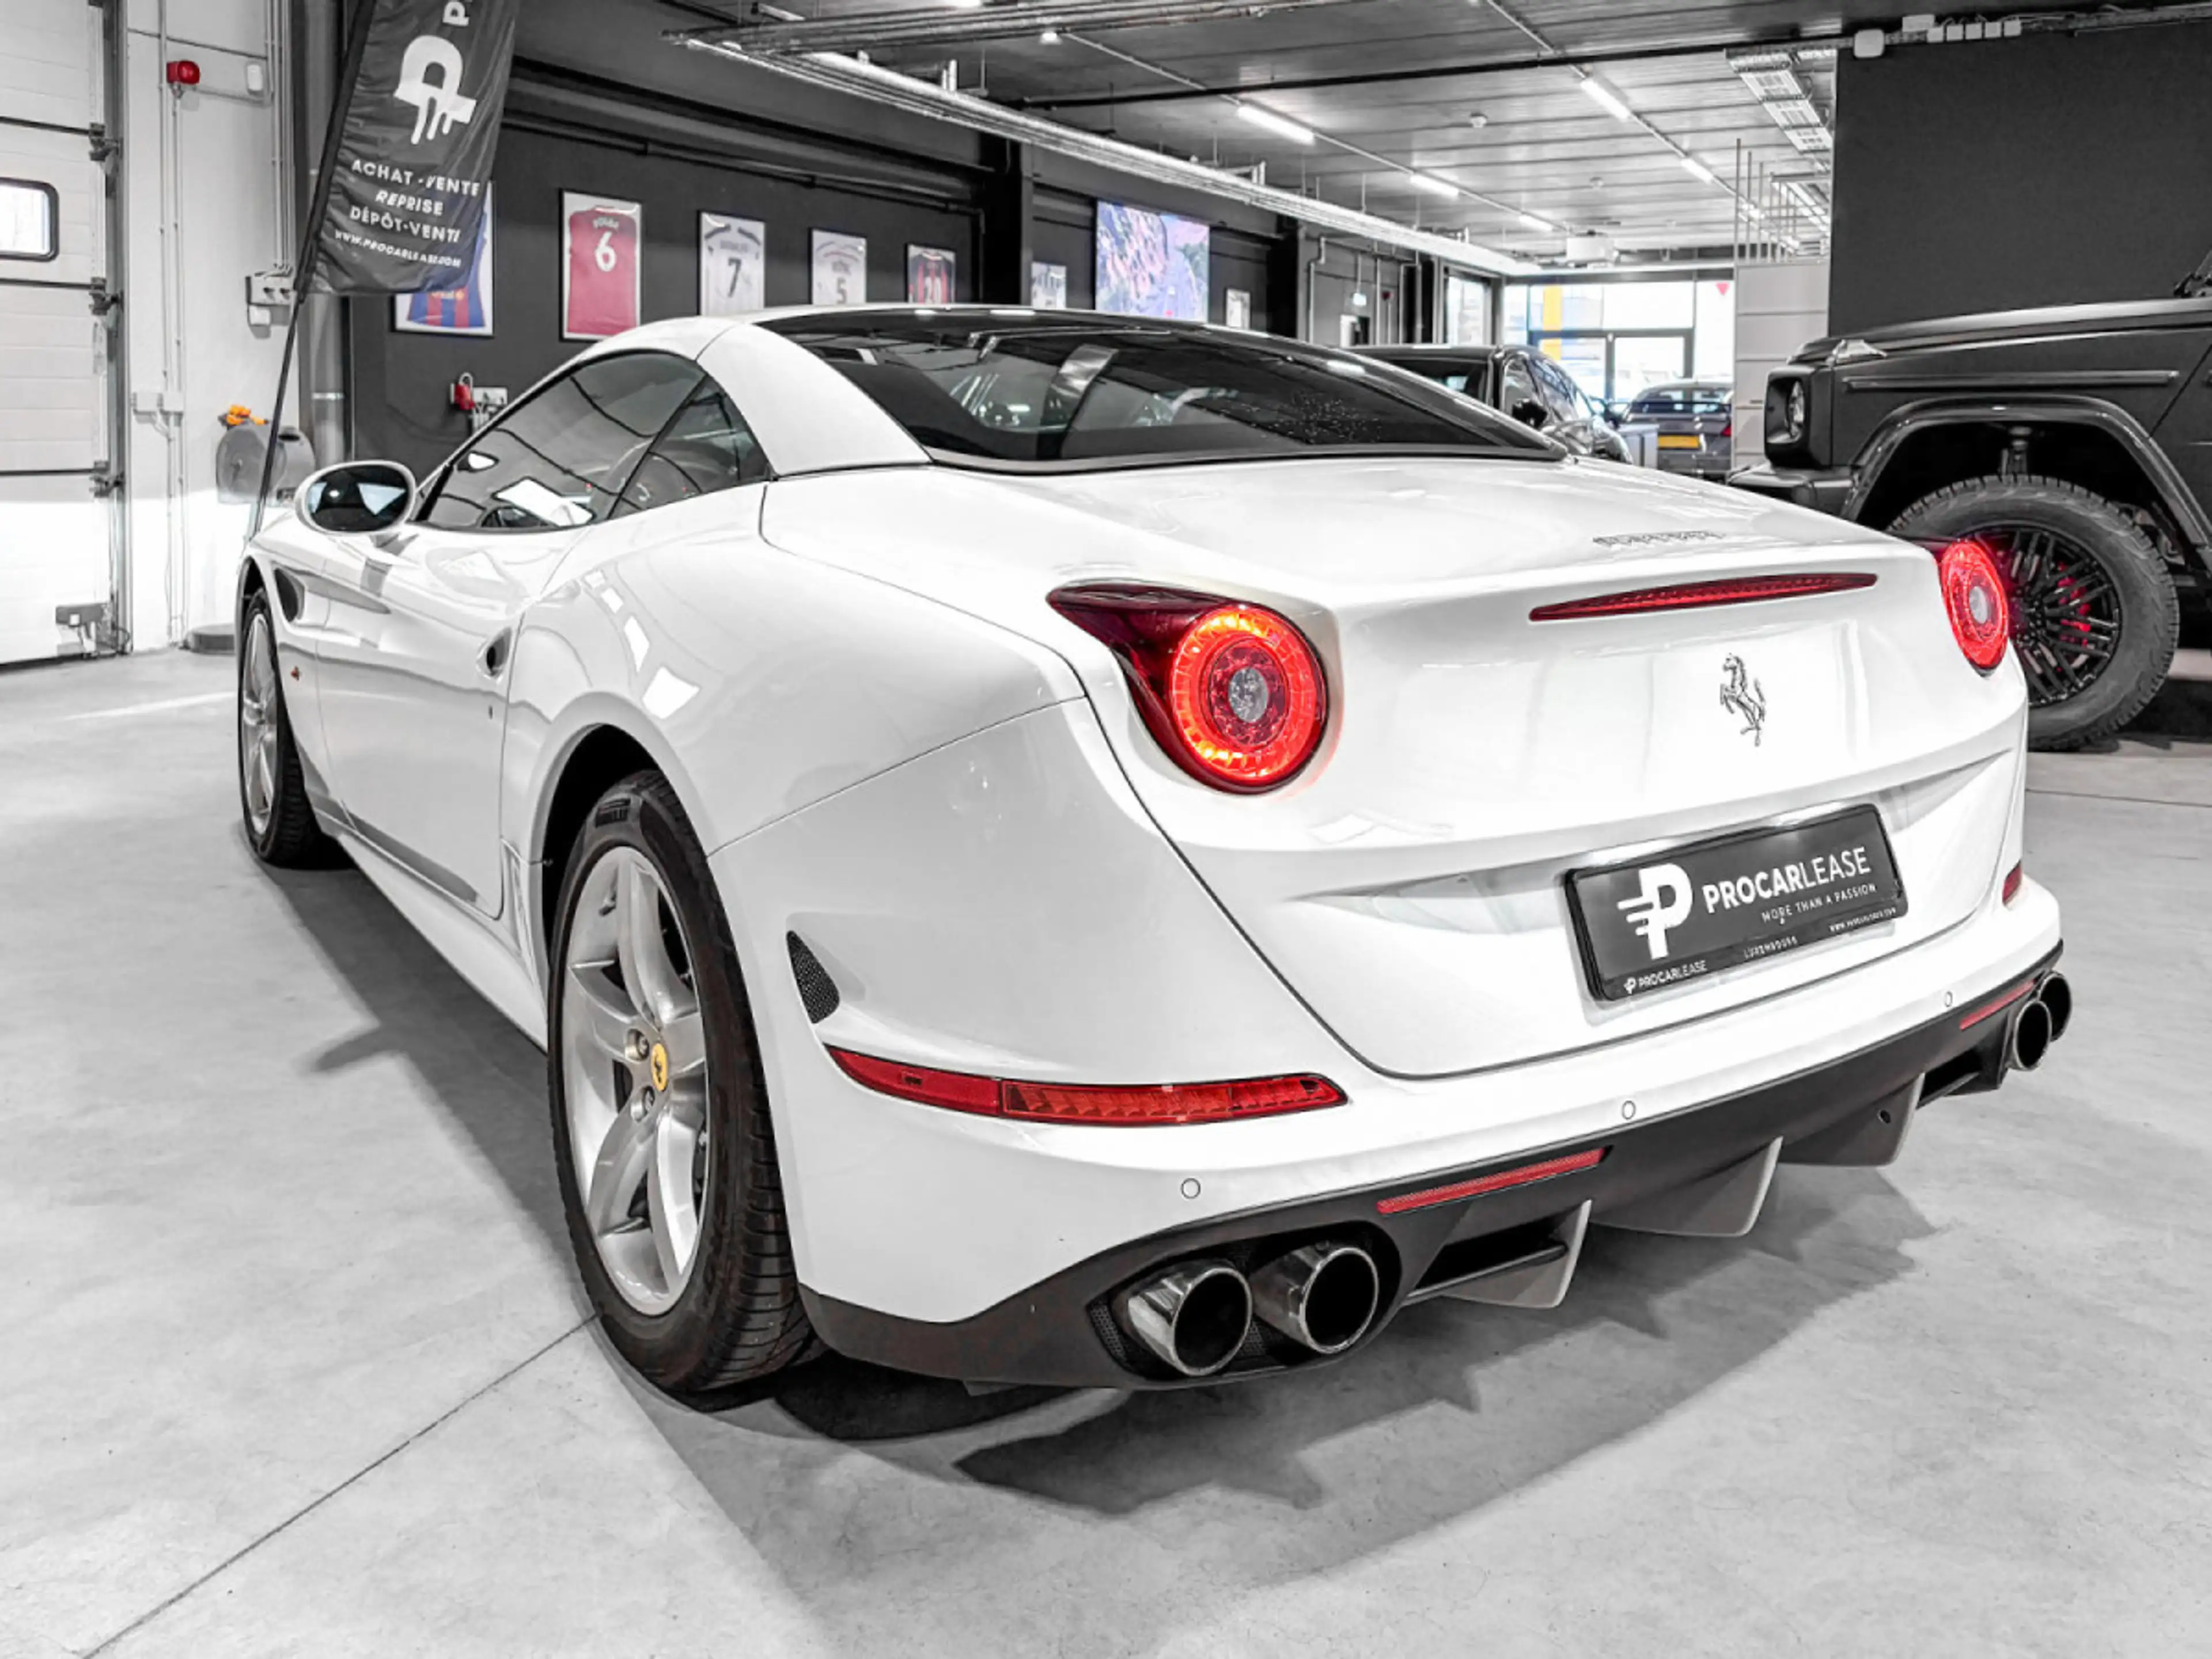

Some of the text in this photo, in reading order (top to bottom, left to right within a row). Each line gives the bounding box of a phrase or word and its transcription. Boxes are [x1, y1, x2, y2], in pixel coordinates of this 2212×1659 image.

[352, 159, 414, 185] ACHAT
[375, 189, 444, 216] REPRISE
[594, 230, 618, 272] 6
[728, 257, 742, 298] 7
[836, 276, 848, 304] 5
[1701, 846, 1872, 914] PROCARLEASE
[1760, 882, 1877, 924] MORE THAN A PASSION
[1638, 960, 1708, 988] PROCARLEASE
